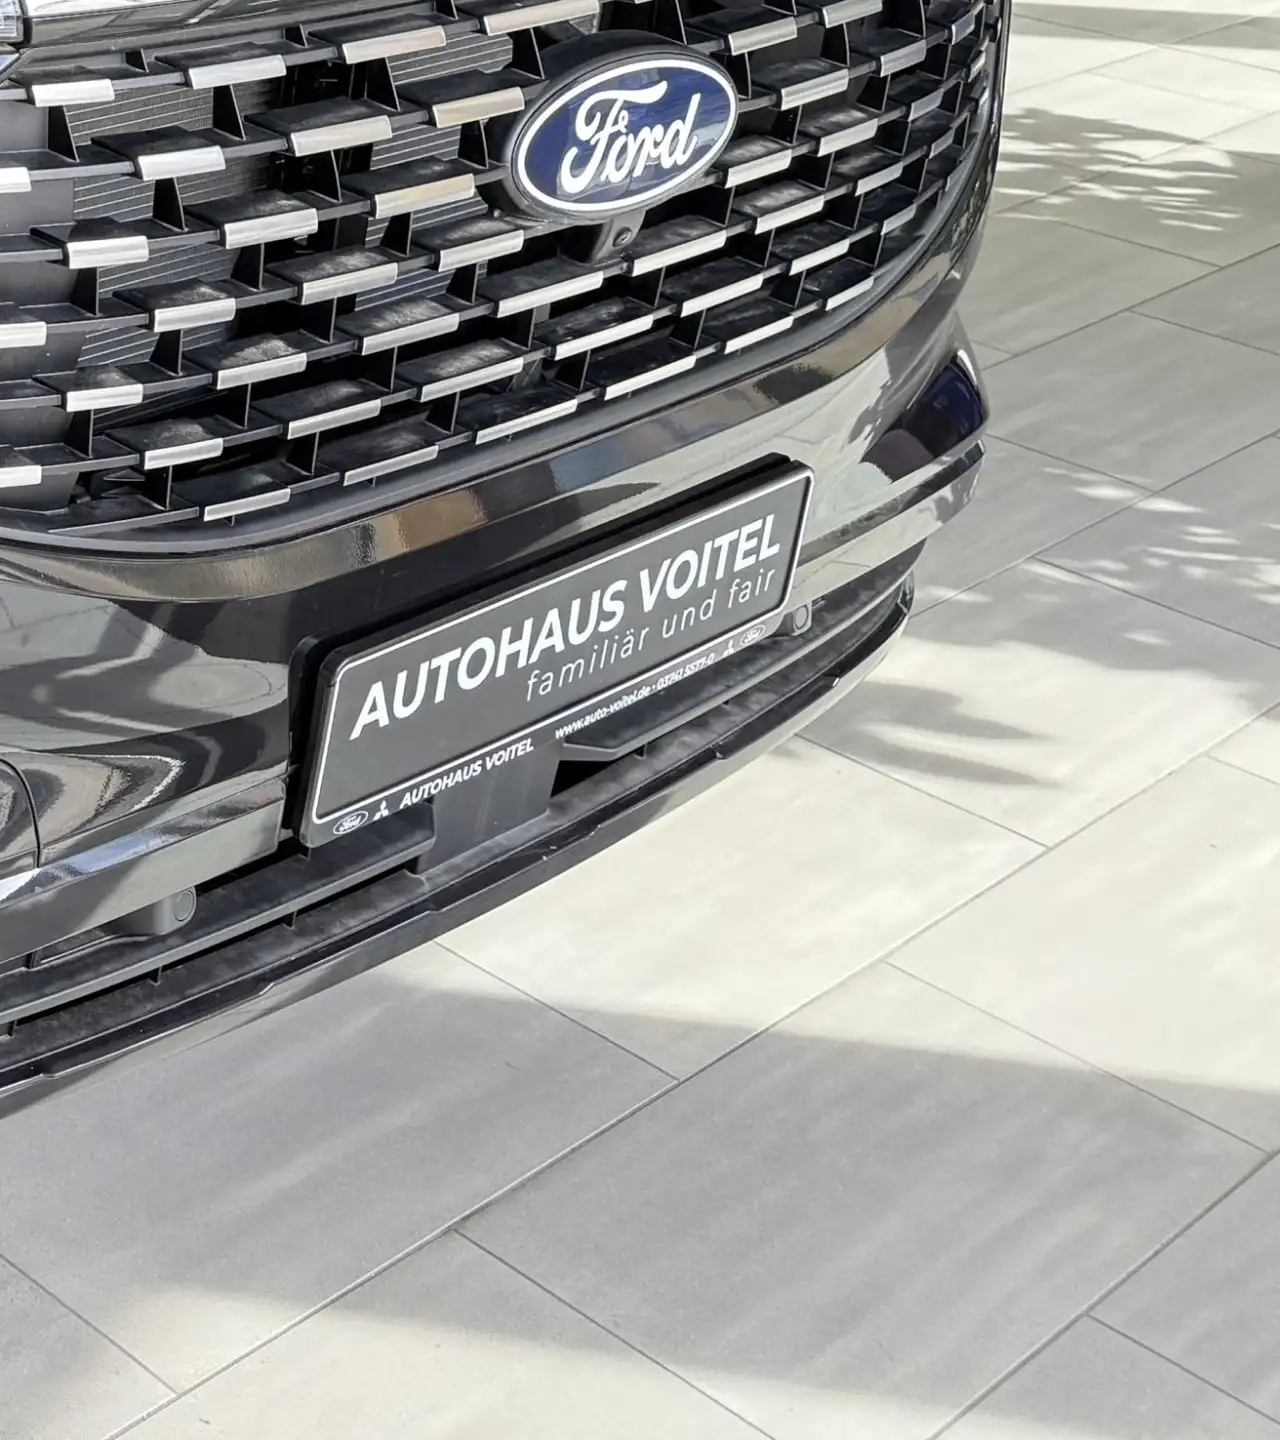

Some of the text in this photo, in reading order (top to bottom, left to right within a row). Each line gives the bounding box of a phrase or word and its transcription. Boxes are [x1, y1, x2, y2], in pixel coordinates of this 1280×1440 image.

[557, 78, 704, 196] Ford
[349, 513, 781, 741] AUTOHAUS VOITEL
[526, 566, 777, 702] familiär und fair
[554, 684, 651, 740] www.auto-voitel.de
[398, 737, 535, 810] AUTOHAUS VOITEL
